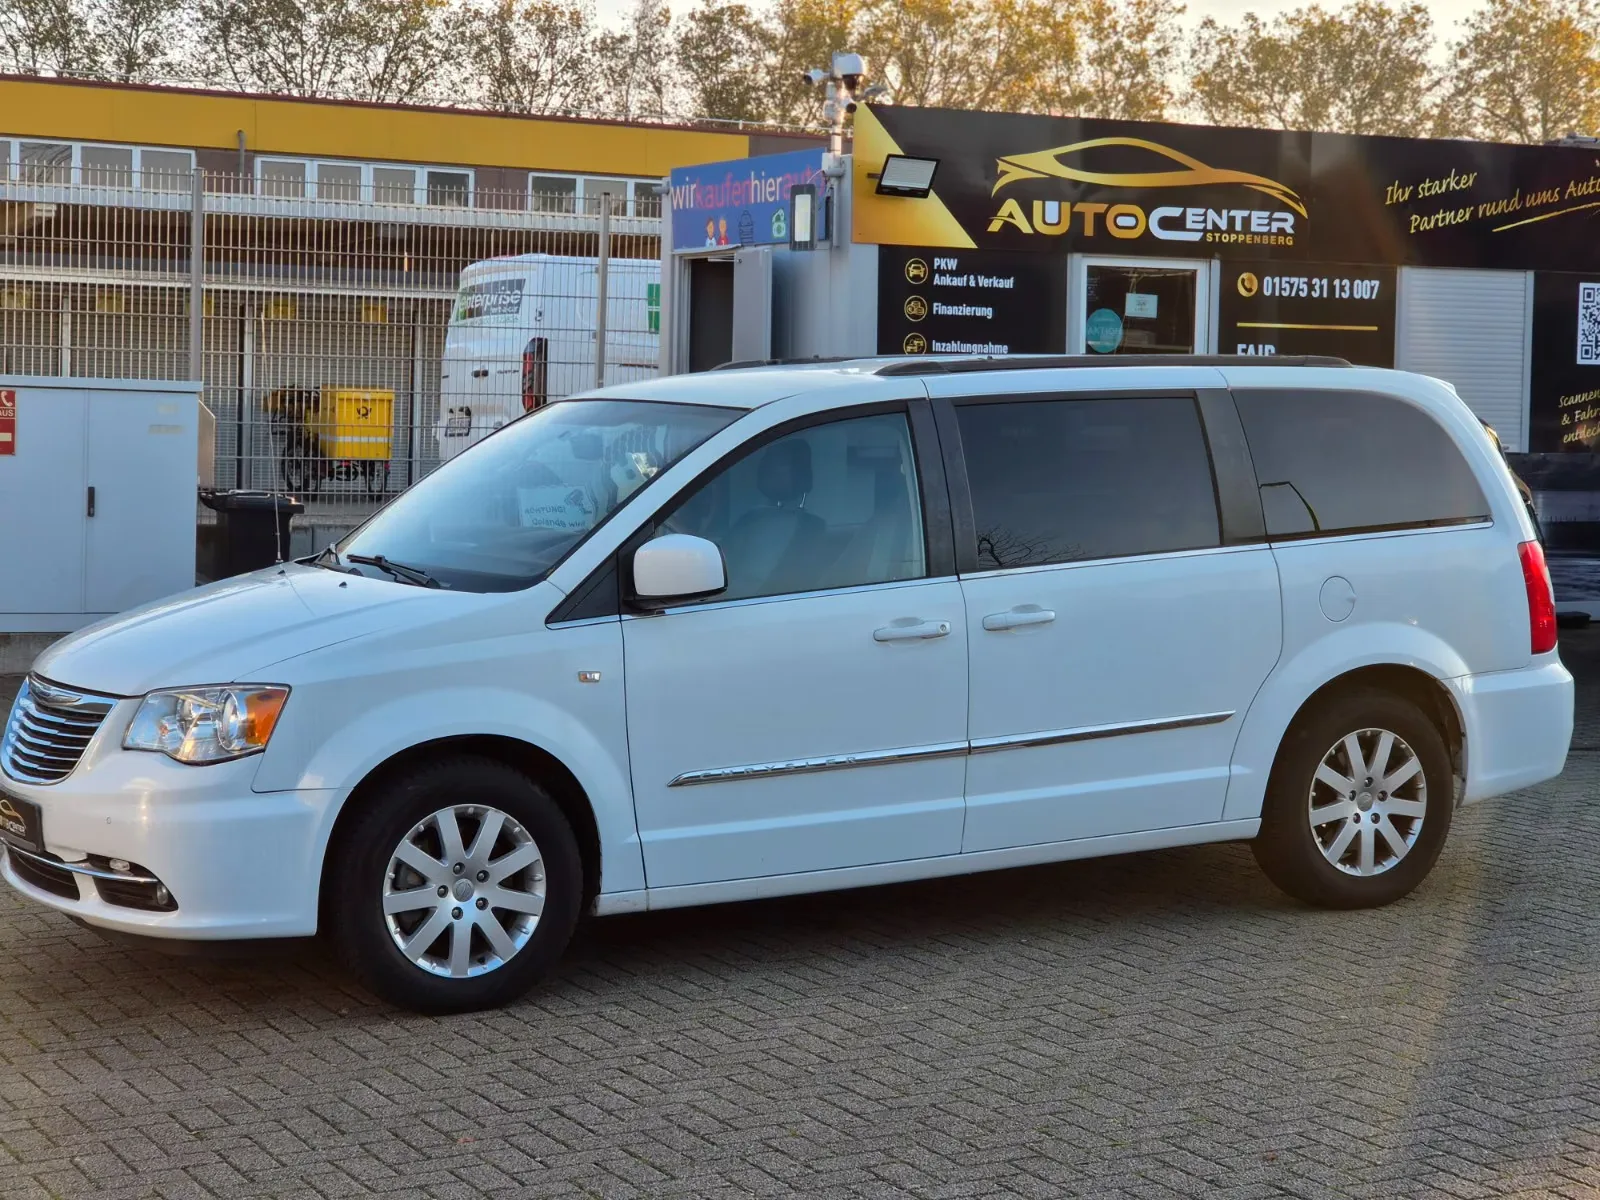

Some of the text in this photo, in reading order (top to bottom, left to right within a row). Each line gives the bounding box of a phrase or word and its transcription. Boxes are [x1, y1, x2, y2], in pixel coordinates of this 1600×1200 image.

[1385, 168, 1478, 205] Ihr starker
[1409, 207, 1474, 233] Partner
[1478, 188, 1522, 218] rund
[1525, 187, 1560, 208] ums
[1206, 232, 1293, 246] STOPPENBERG
[933, 257, 958, 270] PKW
[933, 273, 1015, 289] Ankauf & Verkauf
[1263, 276, 1380, 299] 01575 31 13 007
[932, 302, 993, 319] Finanzierung
[932, 340, 1009, 355] Inzahlungnahme
[1561, 404, 1600, 425] & Fahr
[700, 757, 857, 779] CHRYSLER
